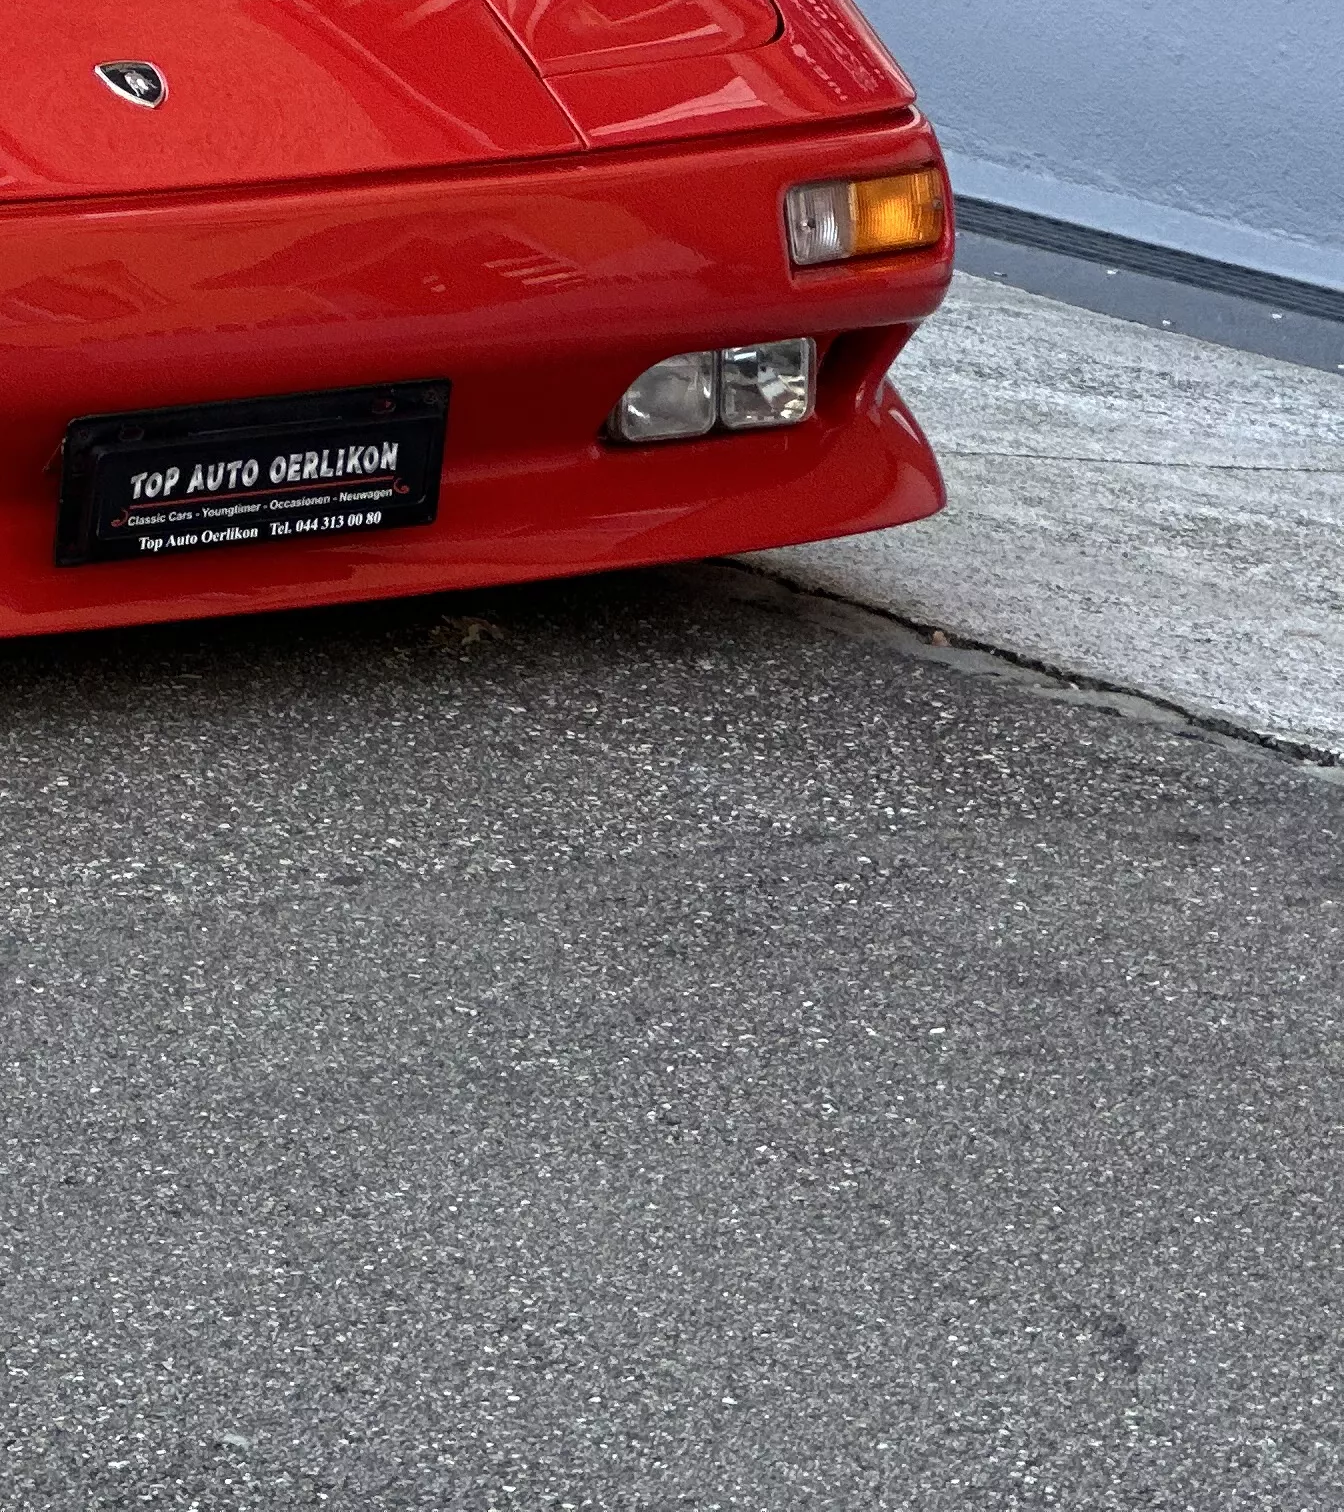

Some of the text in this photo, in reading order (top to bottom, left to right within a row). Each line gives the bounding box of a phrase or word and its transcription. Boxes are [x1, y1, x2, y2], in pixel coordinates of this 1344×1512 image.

[130, 441, 400, 500] TOP AUTO OERLIKON
[127, 512, 166, 527] Classic
[168, 509, 193, 523] Cars
[202, 502, 261, 519] Youngtimer
[269, 494, 330, 510] Occasionen
[339, 488, 393, 503] Neuwagen
[139, 510, 382, 552] Top Auto Oerlikon Tel. 044 313 00 80
